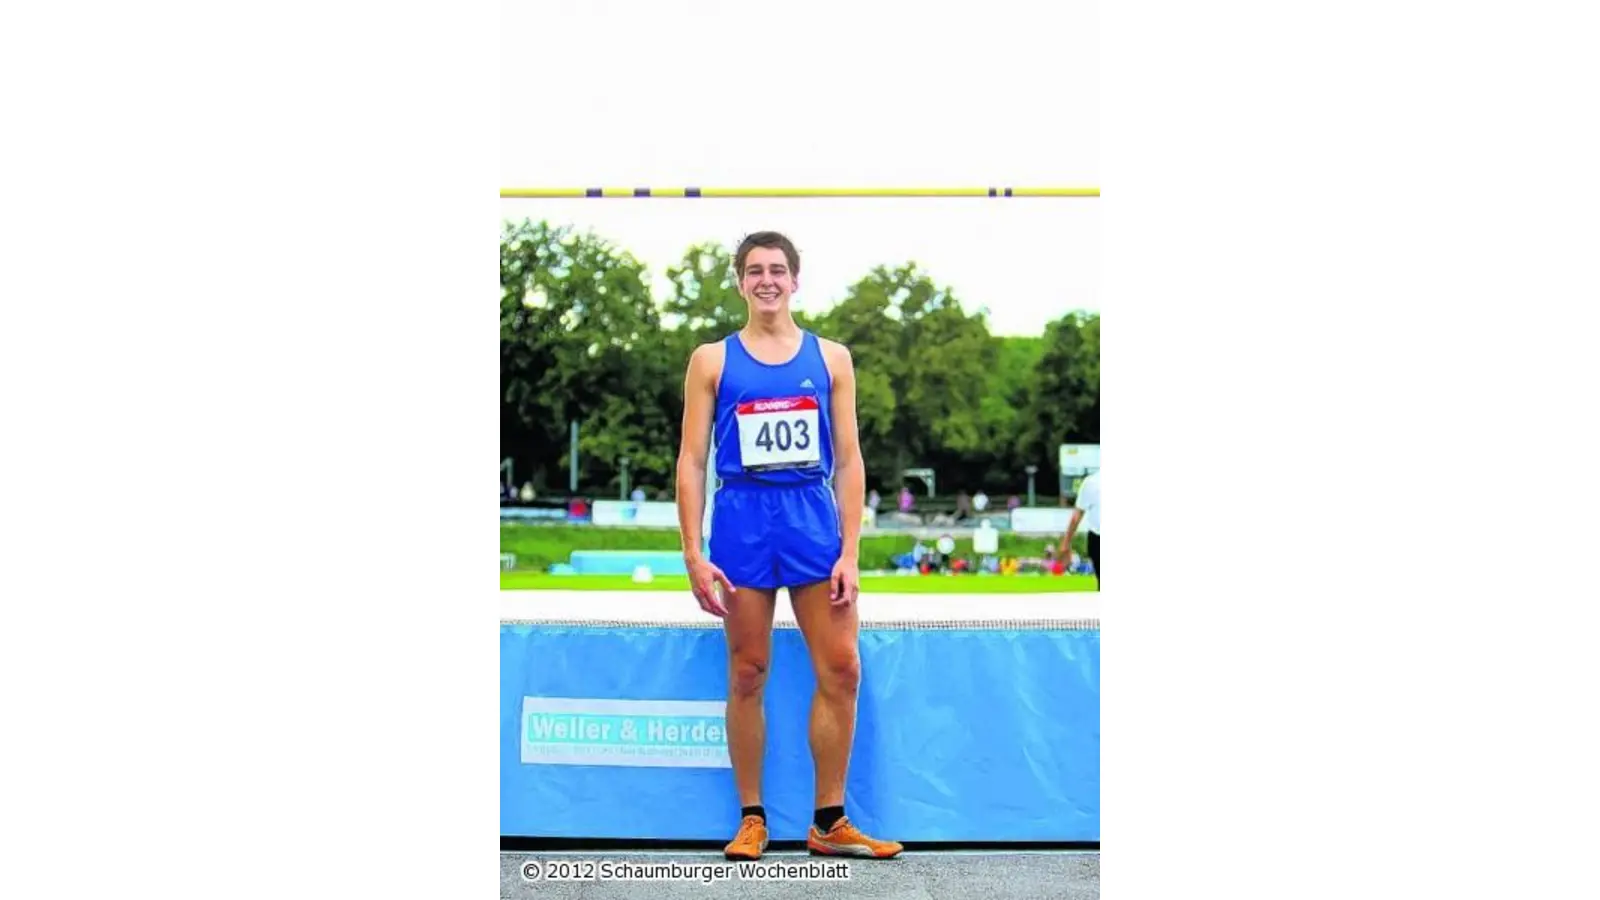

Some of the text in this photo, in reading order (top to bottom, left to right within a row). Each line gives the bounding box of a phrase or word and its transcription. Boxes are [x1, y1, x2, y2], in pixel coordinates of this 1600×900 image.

[755, 419, 811, 452] 403
[531, 714, 612, 740] Weller
[620, 718, 638, 741] &
